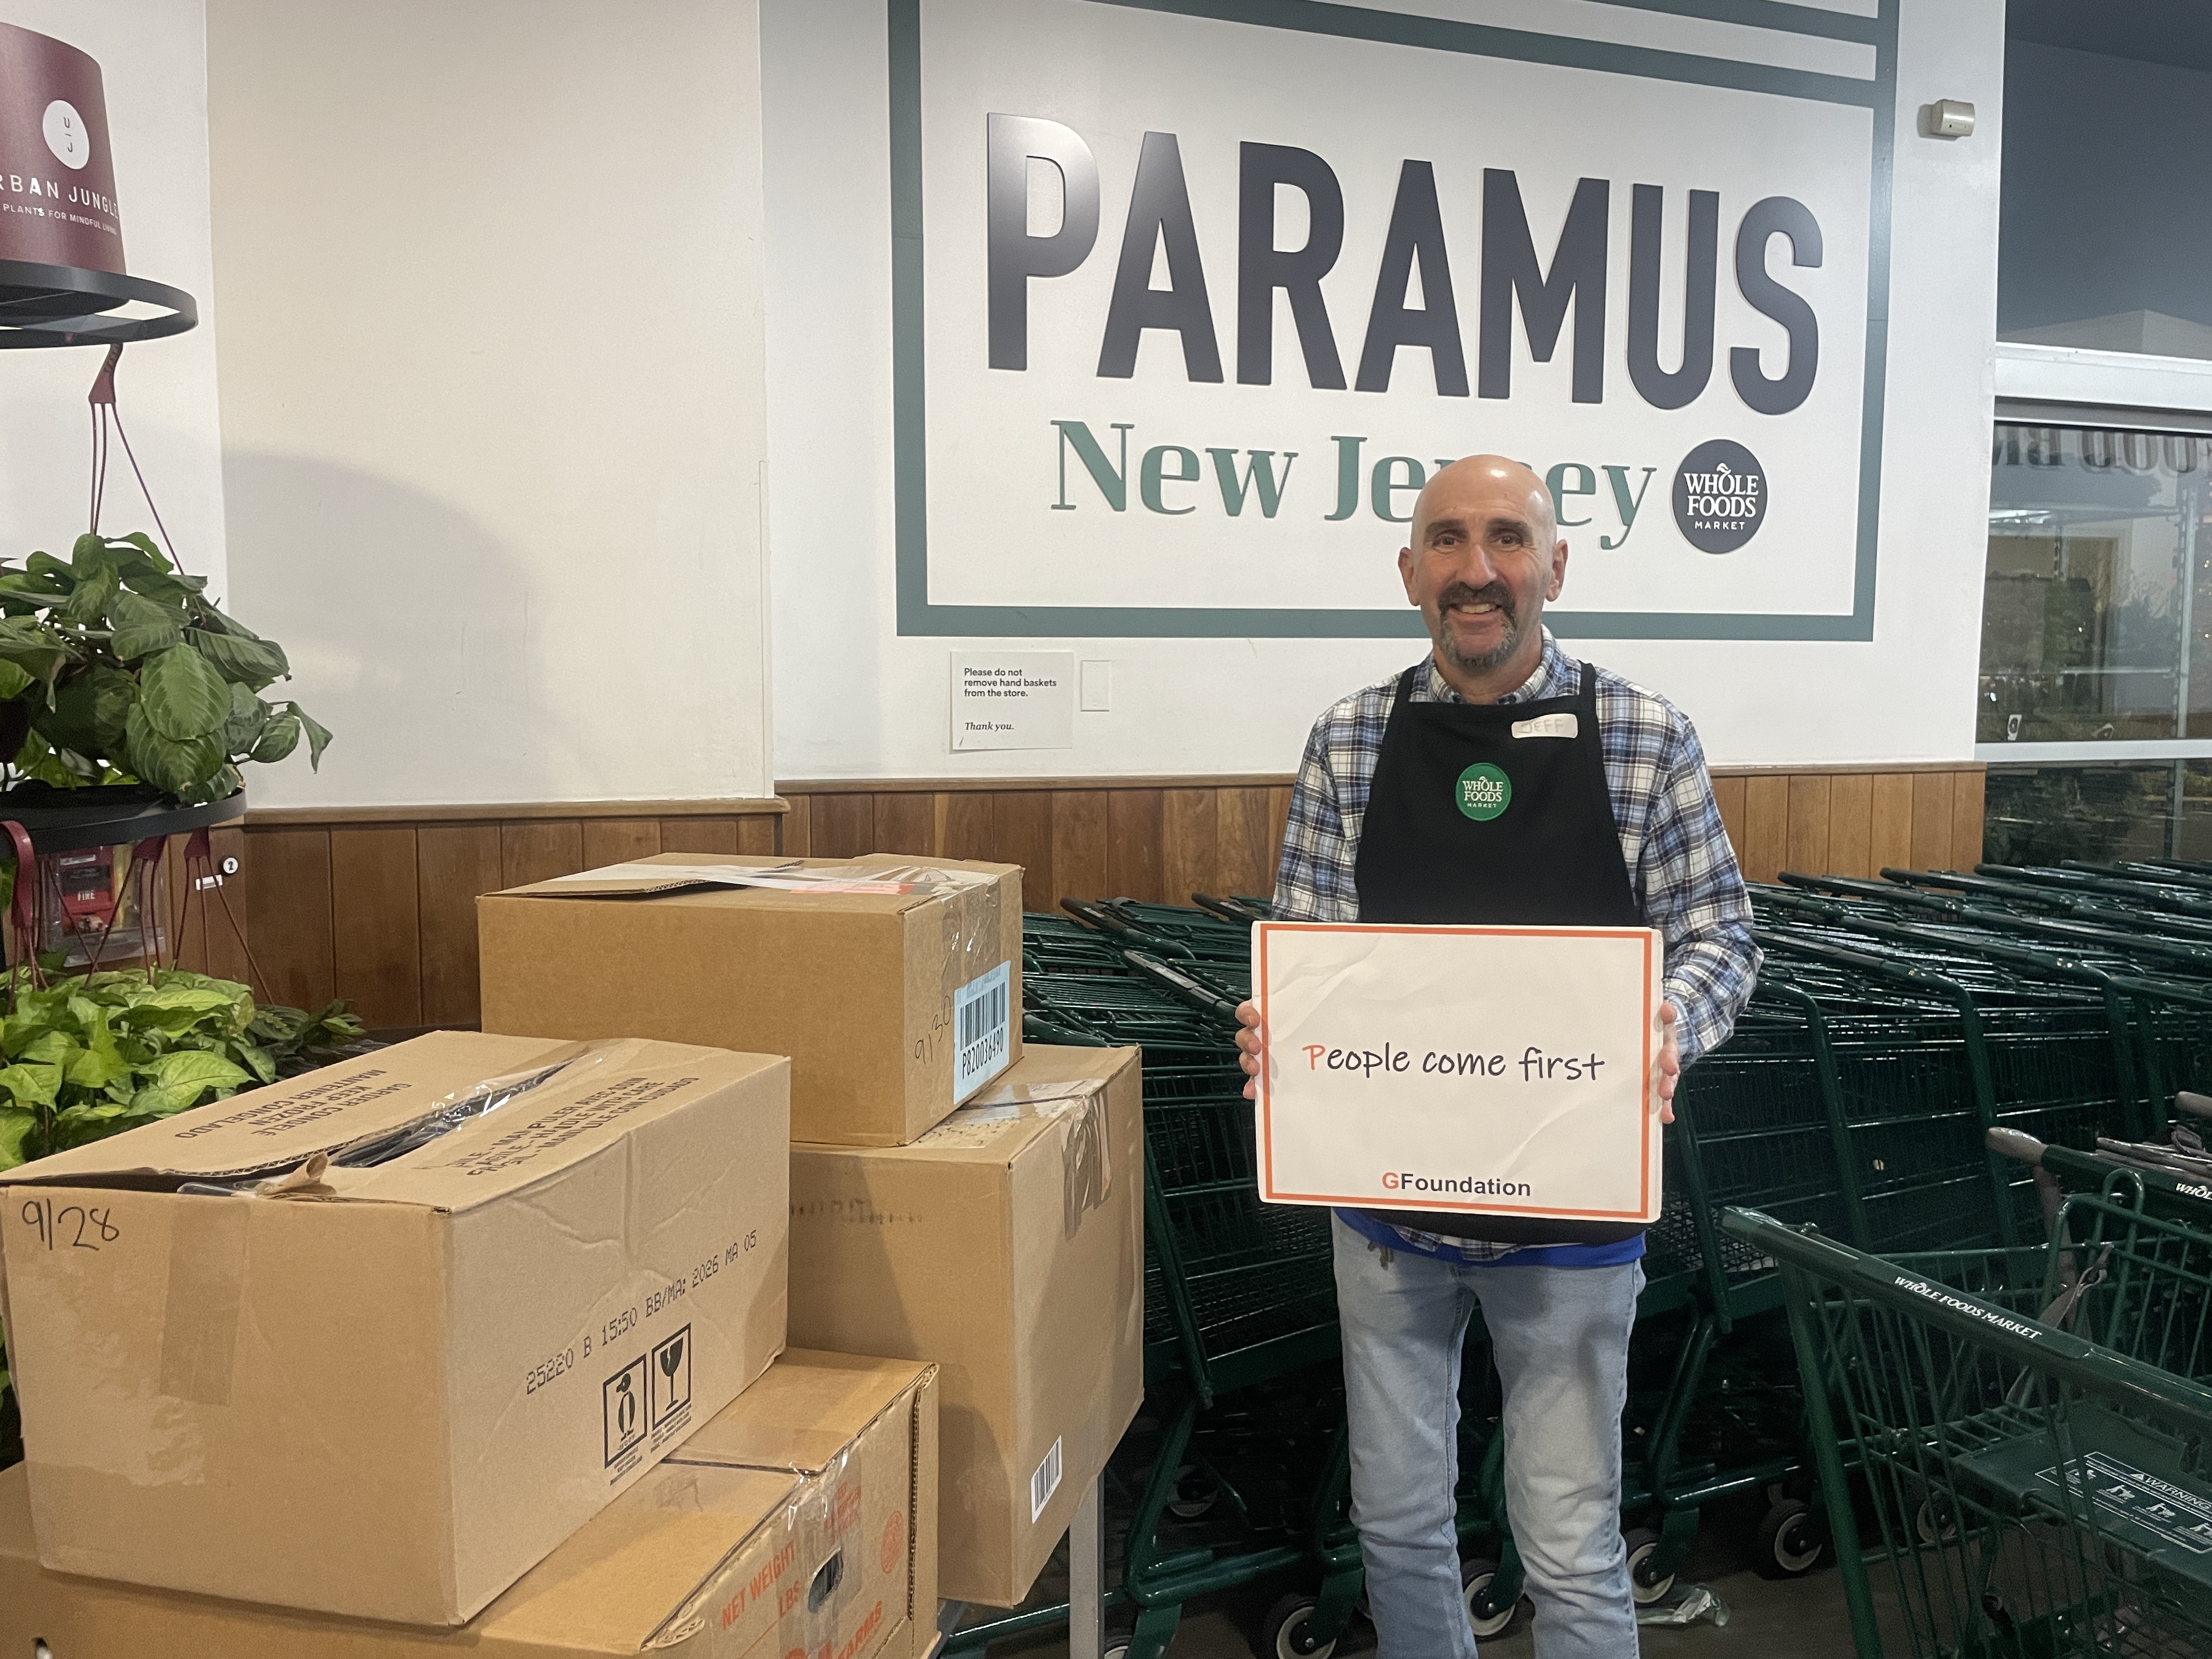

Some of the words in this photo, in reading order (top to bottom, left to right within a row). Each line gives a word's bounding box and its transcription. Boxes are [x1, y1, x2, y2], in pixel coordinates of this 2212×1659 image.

[3, 202, 45, 217] PLANTS
[48, 210, 67, 221] FOR
[69, 213, 101, 229] MINDFUL
[986, 111, 1825, 417] PARAMUS
[1049, 419, 1298, 519] New
[1324, 434, 1657, 550] Jeey
[1683, 464, 1759, 495] WHOLE
[1687, 495, 1756, 517] FOODS
[1694, 521, 1745, 531] MARKET
[964, 668, 992, 676] Please
[994, 668, 1006, 676] do
[1008, 668, 1023, 676] not
[1000, 678, 1022, 687] hand
[1024, 678, 1057, 687] baskets
[964, 689, 985, 697] from
[988, 689, 1002, 697] the
[965, 721, 993, 730] Thank
[995, 723, 1014, 732] you.
[1462, 777, 1504, 792] WHOLE
[1464, 792, 1502, 802] FOODS
[228, 861, 234, 871] 2
[1302, 1042, 1410, 1079] People
[1422, 1051, 1506, 1077] come
[1519, 1047, 1605, 1081] first
[289, 1069, 388, 1100] MANTENER
[326, 1086, 373, 1101] KEEP
[337, 1083, 413, 1107] GARDER
[585, 1097, 632, 1111] WITH
[621, 1081, 665, 1096] CARE
[174, 1100, 295, 1138] CONGELADO
[247, 1101, 328, 1126] FROZEN
[610, 1101, 648, 1114] CON
[1382, 1172, 1531, 1197] GFoundation
[2175, 1182, 2212, 1201] WHOL
[526, 1347, 574, 1395] 25220
[602, 1306, 638, 1346] 15:50
[645, 1278, 686, 1318] BB/MA:
[691, 1254, 719, 1289] 2026
[725, 1242, 739, 1266] MA
[743, 1229, 757, 1252] 05
[1894, 1276, 1942, 1300] WHOLE
[1938, 1295, 1985, 1317] FOODS
[1980, 1312, 2043, 1340] MARKET
[2145, 1476, 2212, 1510] WARNING
[721, 1587, 746, 1632] NET
[749, 1539, 795, 1601] WEIGHT
[778, 1579, 800, 1620] LBS
